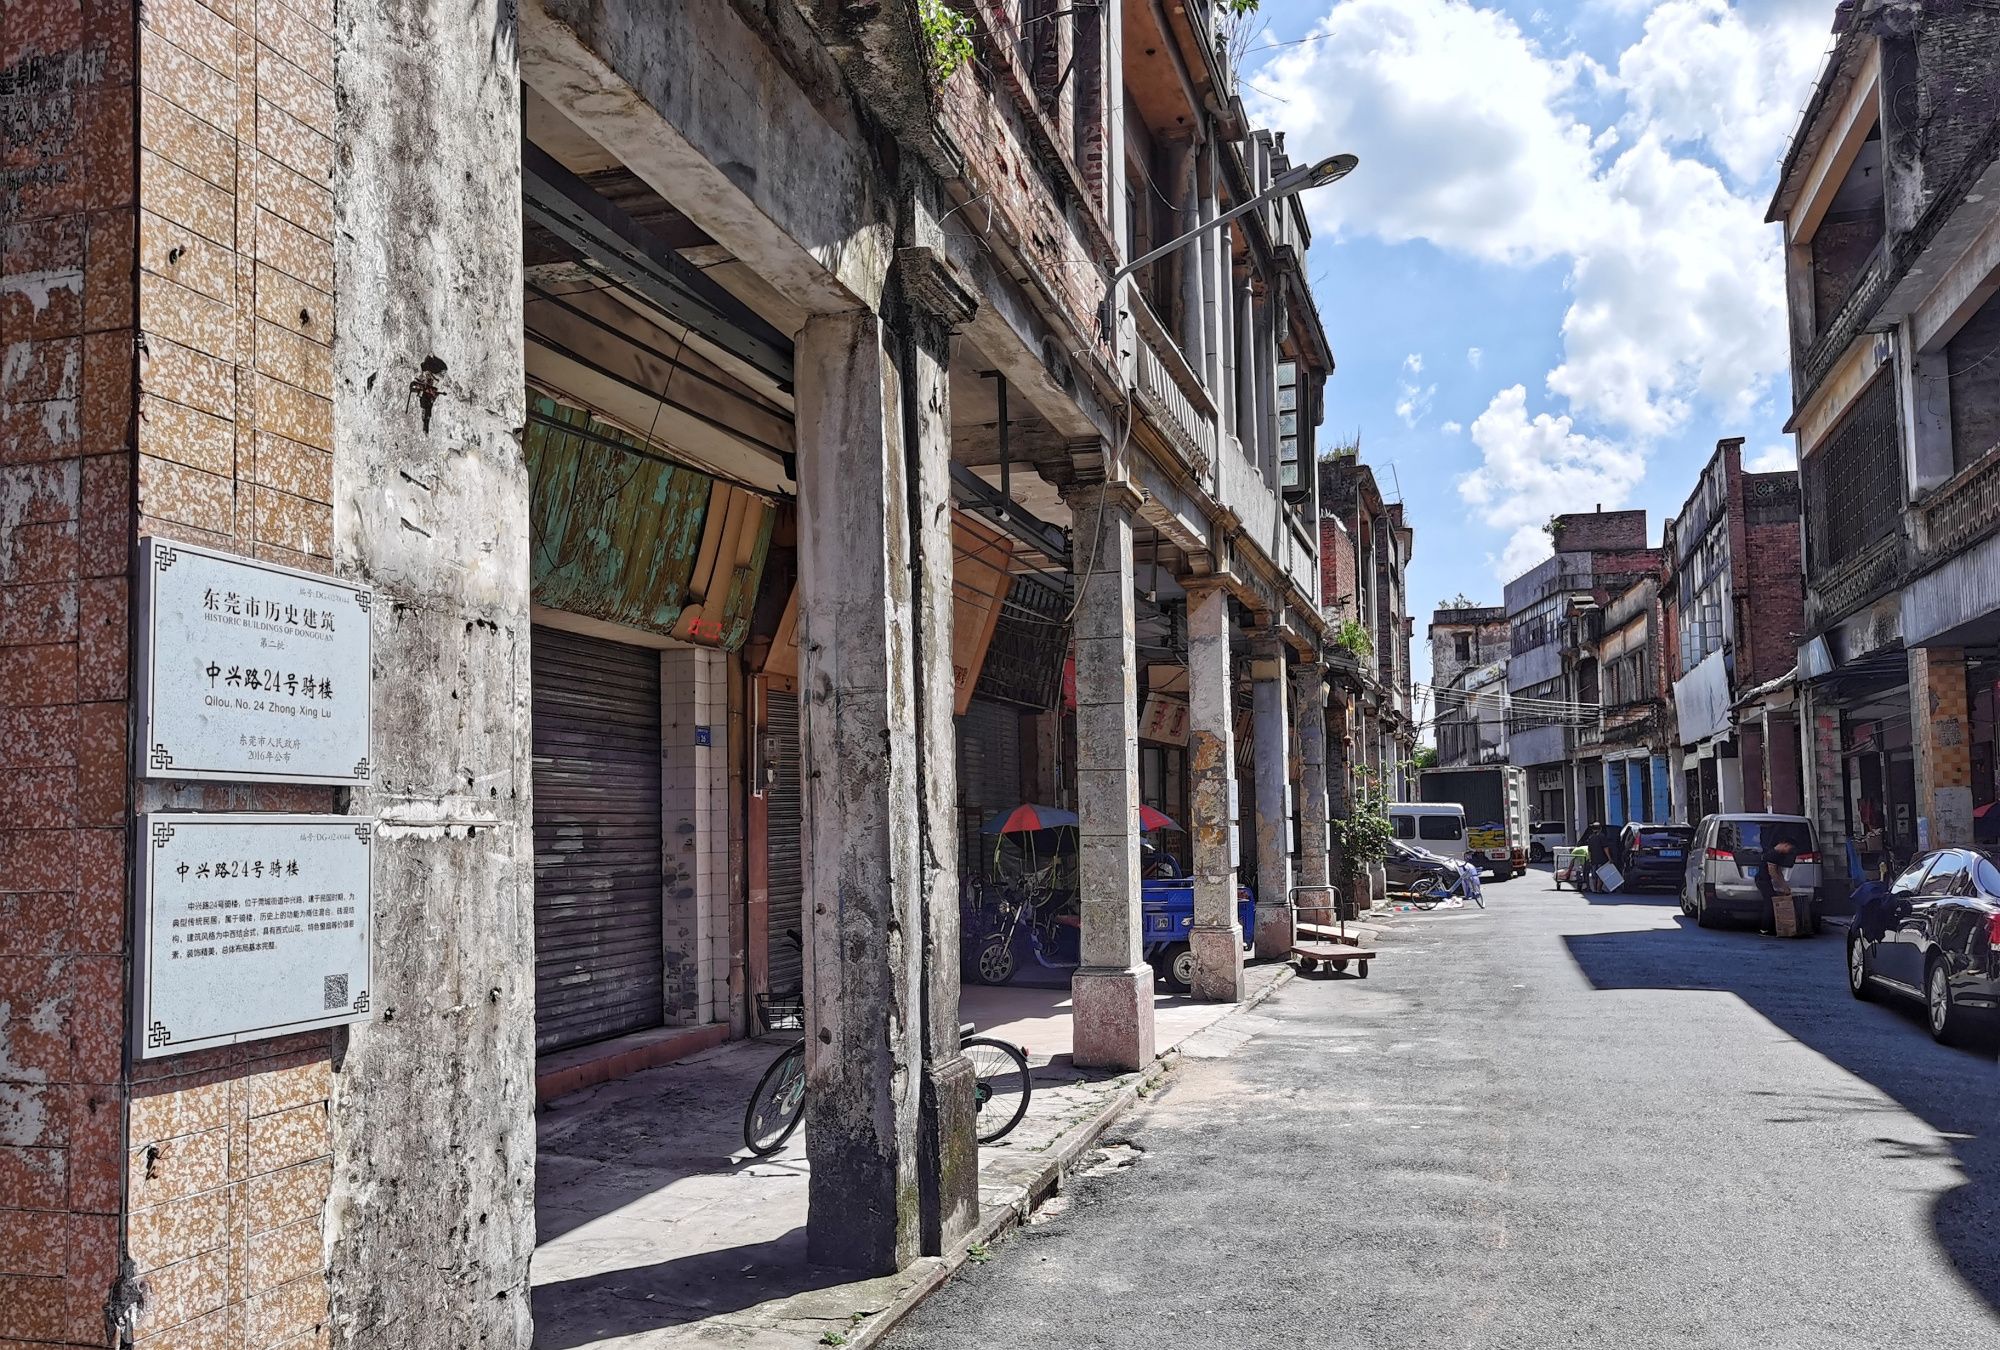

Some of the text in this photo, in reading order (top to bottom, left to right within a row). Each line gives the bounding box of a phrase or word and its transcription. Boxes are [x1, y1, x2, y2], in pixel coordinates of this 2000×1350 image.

[203, 588, 336, 632] 东莞市历史建筑
[204, 612, 335, 642] HISTORIC BUILDINGS OF DONGGUAN
[205, 660, 334, 701] 中兴路24号骑楼
[235, 698, 251, 710] No.
[253, 700, 265, 711] 24
[268, 702, 296, 717] Zhong
[299, 705, 318, 719] Xing
[321, 708, 332, 718] Lu
[239, 734, 302, 750] 东莞市人民政府
[248, 751, 292, 763] 2016年公布
[176, 858, 301, 883] 中兴路24号骑楼
